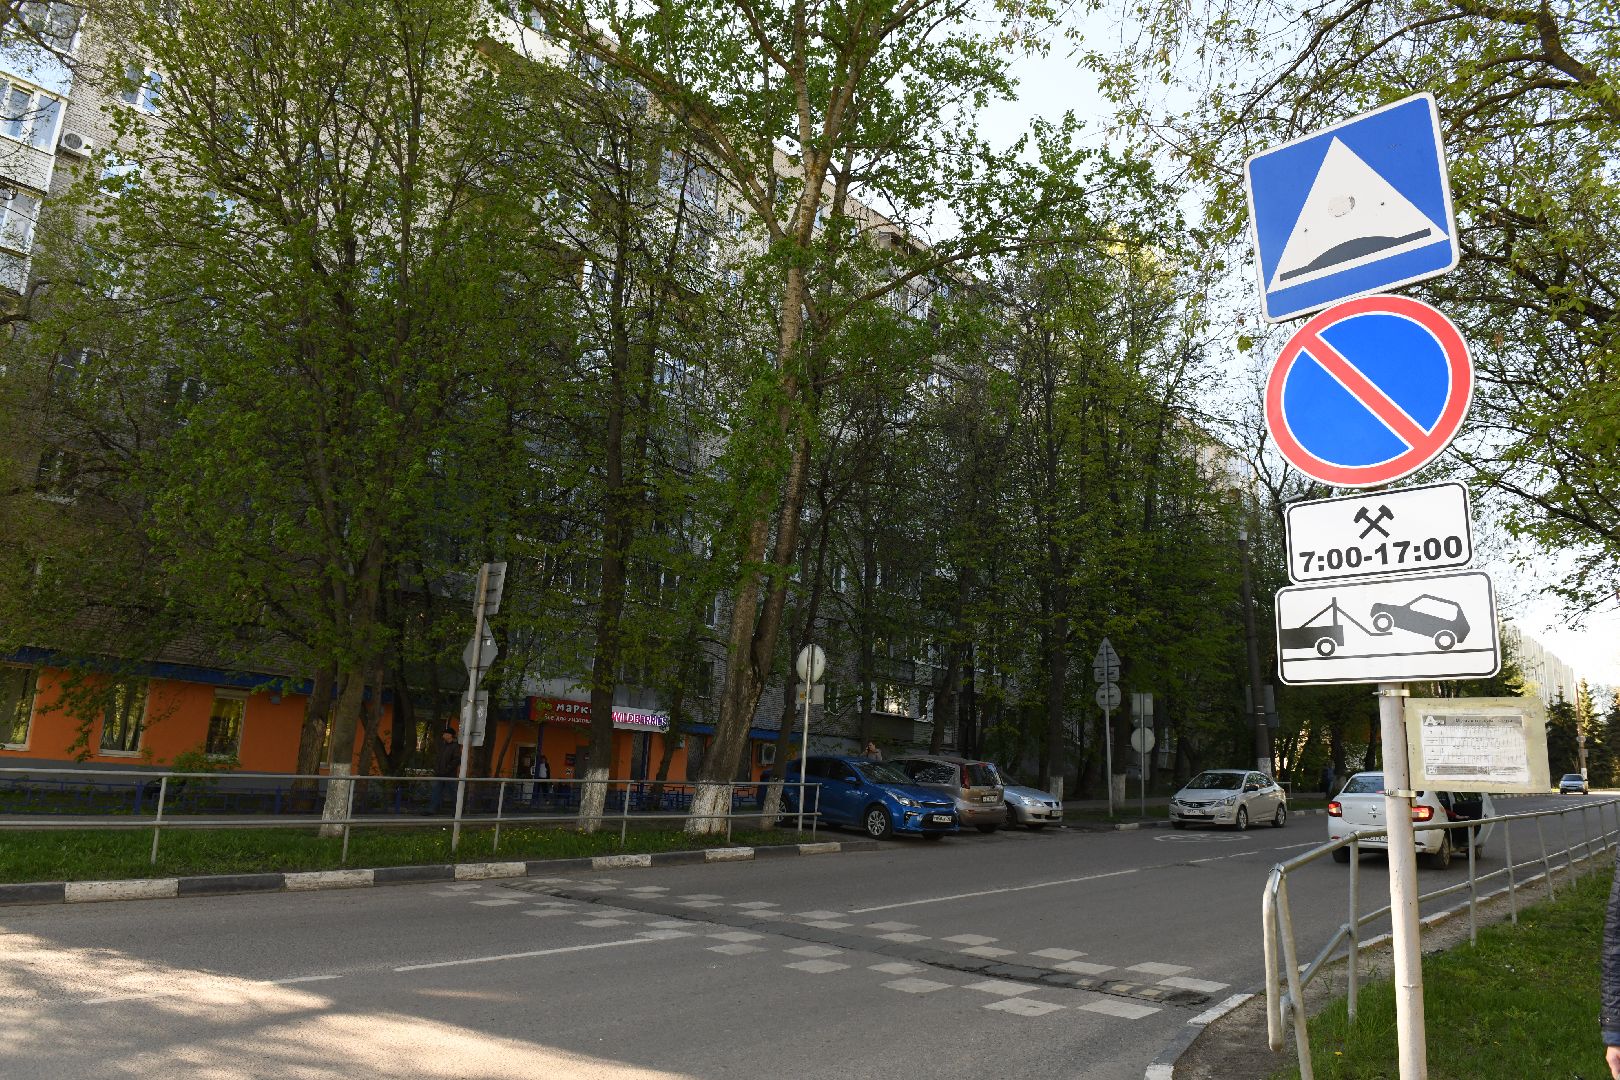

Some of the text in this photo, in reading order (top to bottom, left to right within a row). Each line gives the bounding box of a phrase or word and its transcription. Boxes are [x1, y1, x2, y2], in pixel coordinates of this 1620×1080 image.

[1299, 535, 1463, 573] 7:00-17:00
[556, 703, 592, 714] марк
[612, 711, 666, 727] WILDBERRIES
